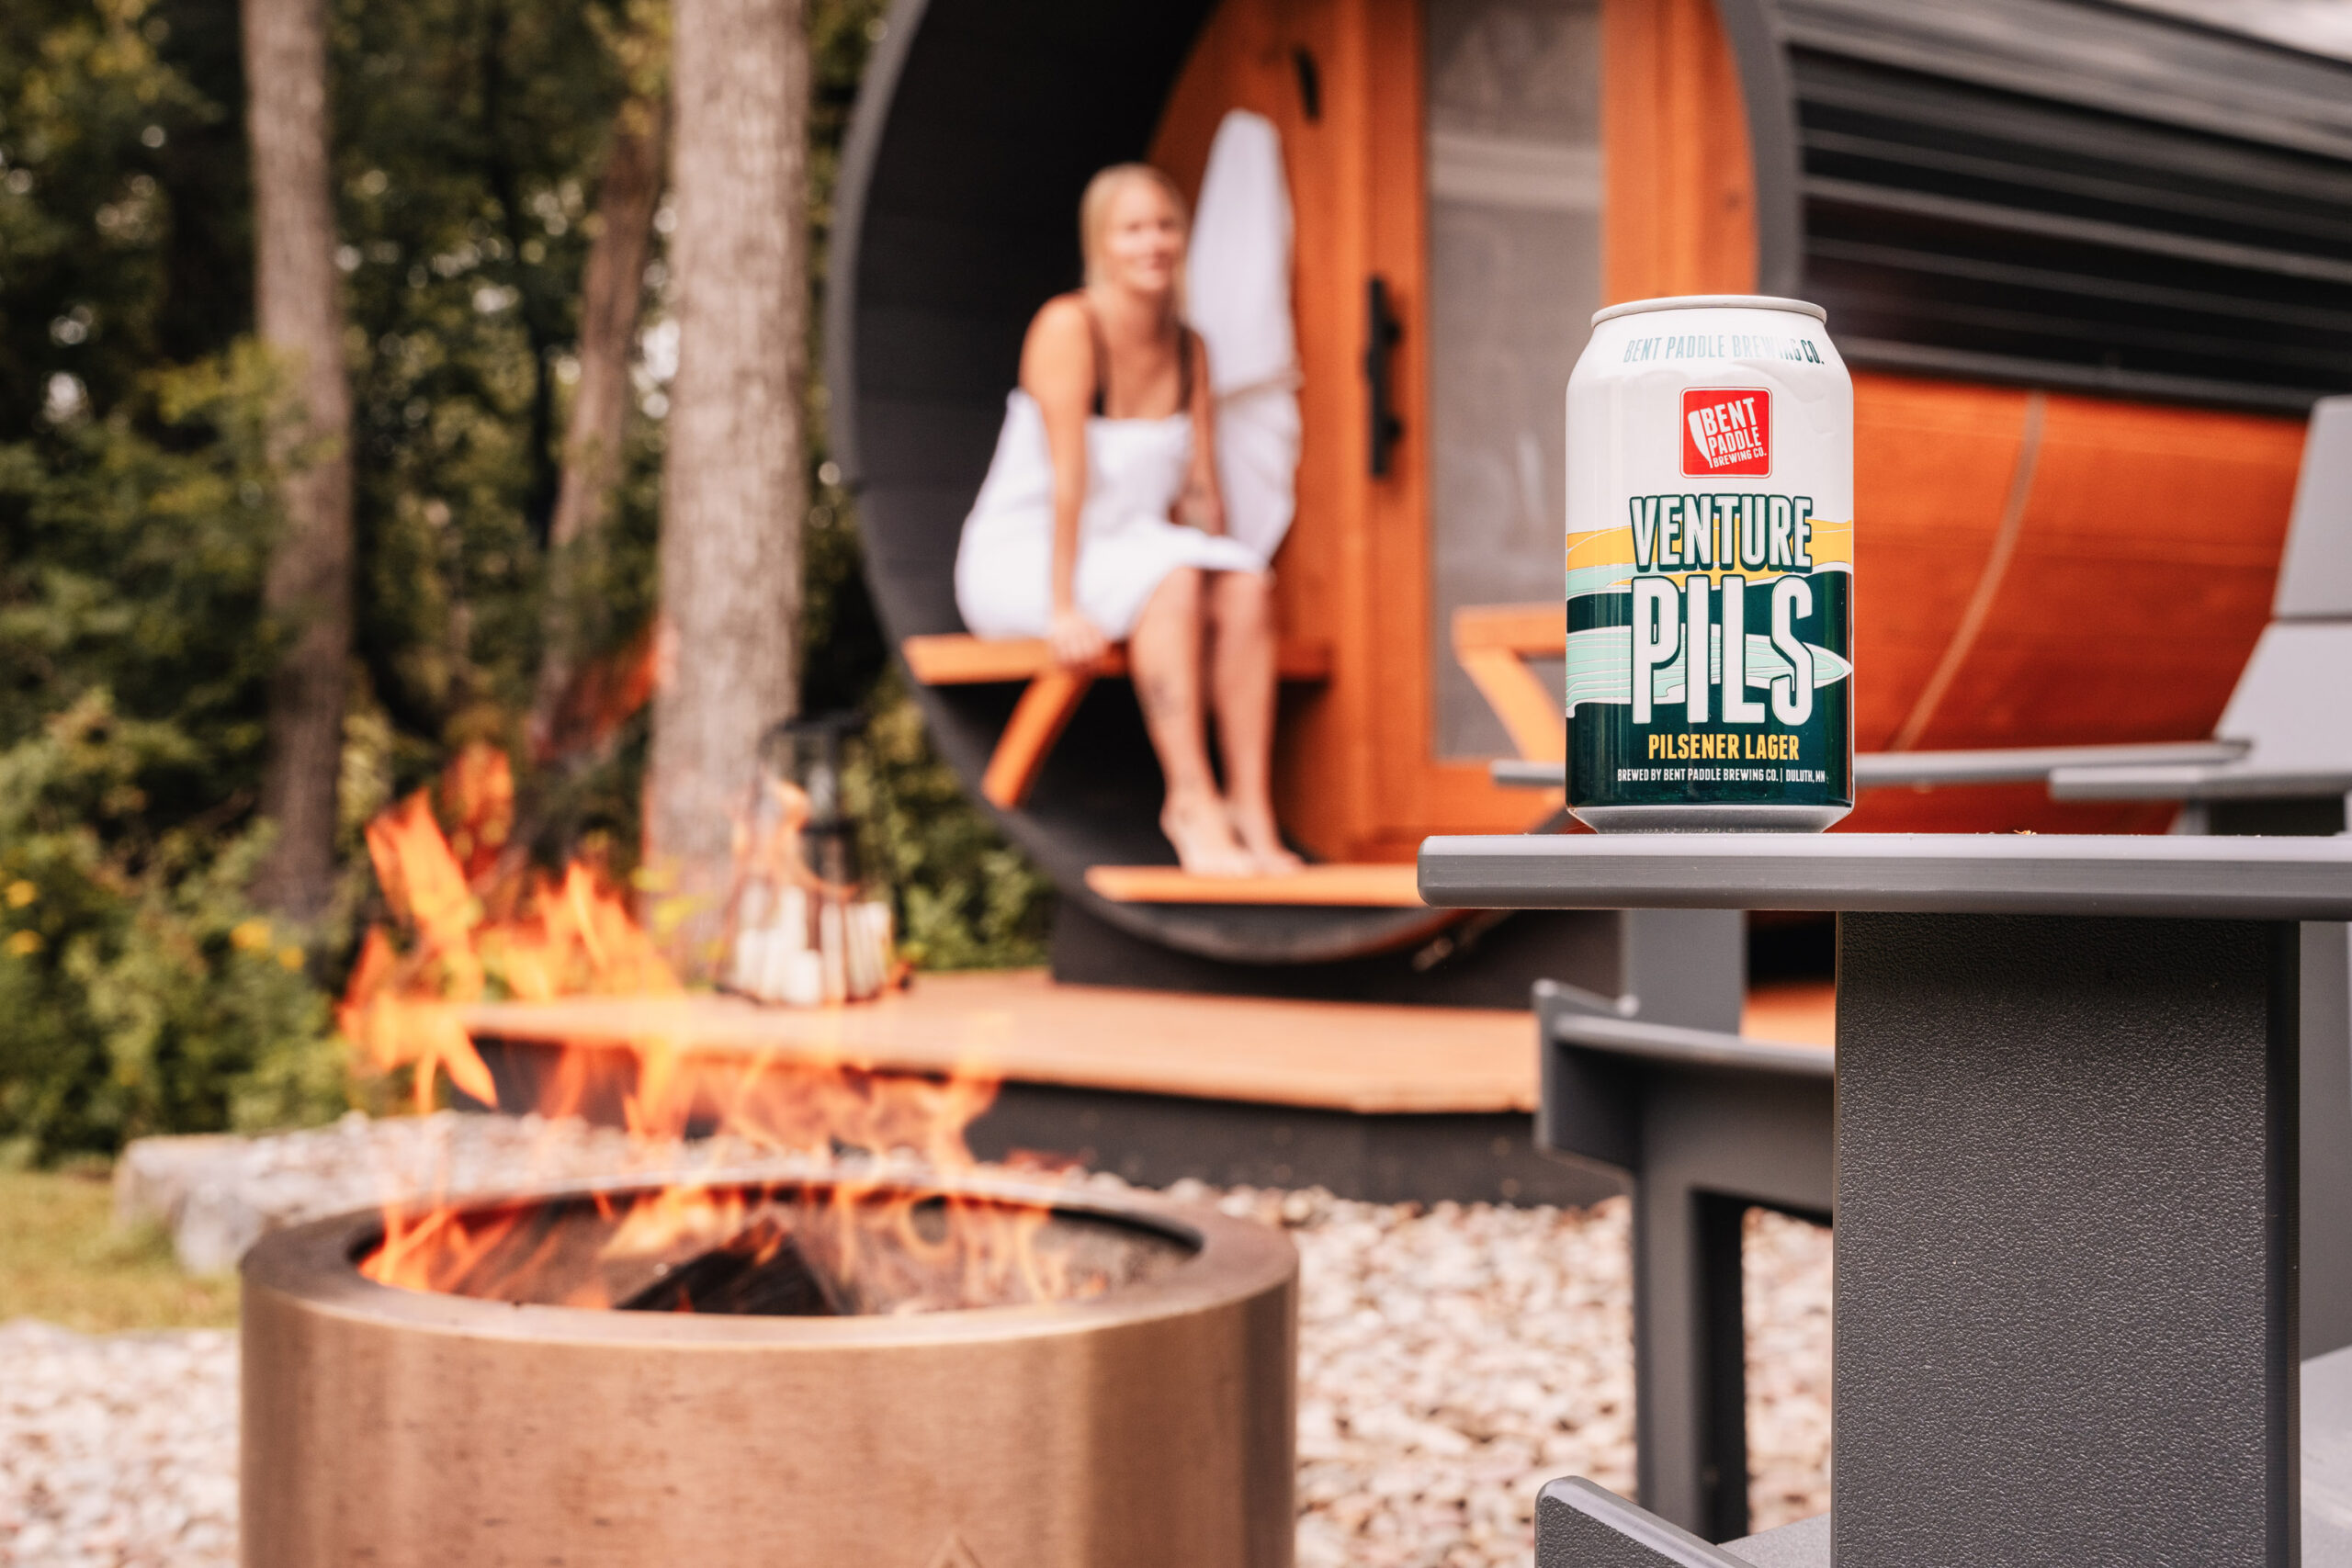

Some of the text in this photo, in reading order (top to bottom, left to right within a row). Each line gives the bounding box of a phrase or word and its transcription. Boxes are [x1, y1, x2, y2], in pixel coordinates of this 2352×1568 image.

[1623, 337, 1662, 363] BENT
[1666, 335, 1724, 359] PADDLE
[1801, 339, 1825, 365] CO.
[1700, 397, 1757, 436] BENT
[1707, 426, 1762, 457] PADDLE
[1713, 446, 1767, 468] BREWING CO.
[1630, 494, 1813, 571] VENTURE
[1631, 575, 1814, 726] PILS
[1648, 734, 1799, 761] PILSENER LAGER
[1617, 768, 1649, 782] BREWED
[1651, 768, 1662, 781] BY
[1663, 768, 1686, 781] BENT
[1687, 768, 1721, 781] PADDLE
[1723, 768, 1764, 782] BREWING
[1765, 769, 1779, 782] CO.
[1785, 770, 1815, 784] DULUTH,
